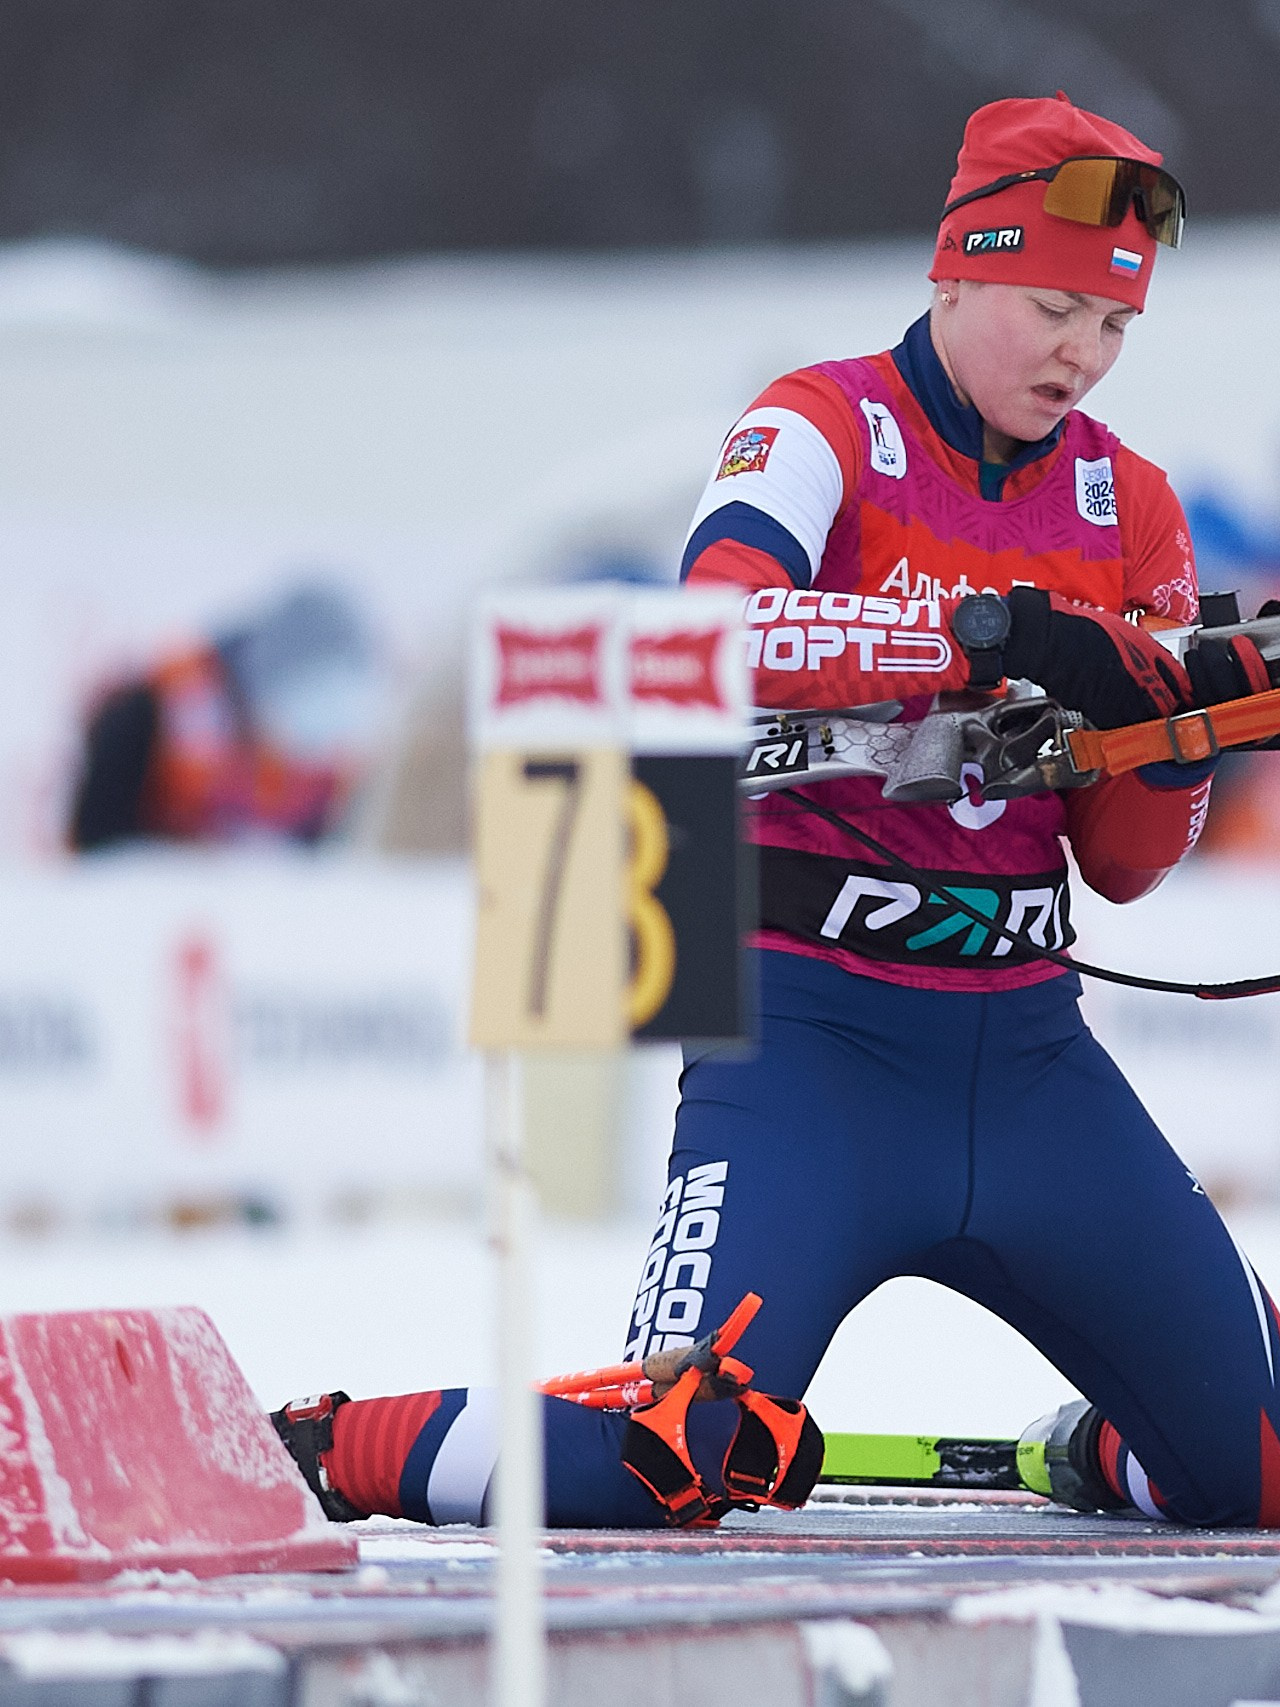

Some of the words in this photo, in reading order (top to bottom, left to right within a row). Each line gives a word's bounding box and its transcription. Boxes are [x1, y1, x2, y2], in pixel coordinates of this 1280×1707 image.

[966, 229, 1021, 251] PARI
[879, 556, 998, 598] Альф
[745, 587, 942, 628] ОСОБЛ
[741, 625, 887, 672] ОРТ
[746, 740, 803, 772] RI
[522, 760, 580, 1018] 7
